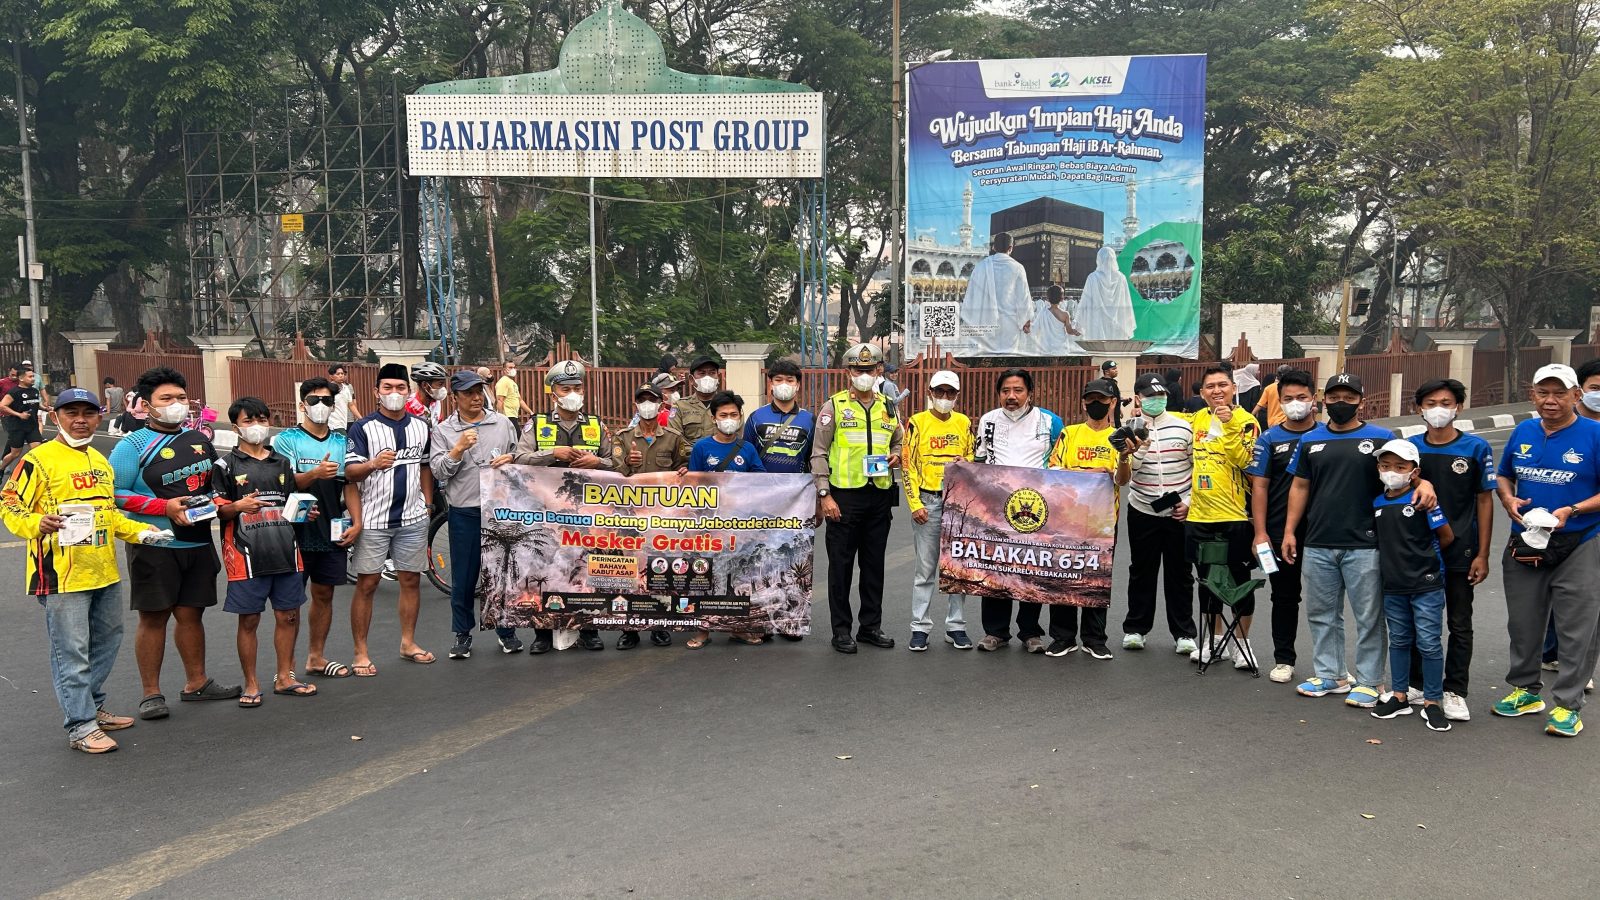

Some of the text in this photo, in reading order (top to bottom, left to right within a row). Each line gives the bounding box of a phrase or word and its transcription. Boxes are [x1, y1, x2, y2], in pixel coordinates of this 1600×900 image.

[1020, 79, 1040, 87] kalsel
[1049, 71, 1070, 88] 22
[1080, 76, 1112, 85] AKSEL
[1029, 106, 1093, 133] Impian
[1093, 105, 1133, 135] Haji
[1132, 107, 1184, 138] Anda
[420, 119, 810, 152] BANJARMASIN POST GROUP
[951, 146, 1003, 164] Bersama
[1004, 140, 1060, 158] Tabungan
[1060, 138, 1085, 155] Haji
[1100, 141, 1163, 159] Ar-Rahman.
[973, 162, 1137, 177] Setoran Awal Ringan, Bebas Biaya Admin
[980, 172, 1125, 186] Persyaratan Mudah, Dapat Bagi Hasil
[1337, 374, 1350, 384] NY
[766, 426, 799, 437] PACAR
[930, 439, 949, 449] CUP
[1078, 450, 1097, 461] CUP
[1515, 465, 1575, 482] PANCAR
[72, 474, 99, 490] CUP
[583, 485, 719, 508] BANTUAN
[495, 509, 543, 525] Warga
[546, 510, 592, 526] Banua
[594, 514, 648, 531] Batang
[561, 530, 736, 551] Masker Gratis !
[951, 541, 1100, 571] BALAKAR 654
[966, 562, 999, 571] (BARISAN
[998, 565, 1034, 576] SUKARELA
[1035, 569, 1078, 579] KEBAKARAN
[592, 617, 626, 625] Balakar
[648, 618, 702, 627] Banjarmasin
